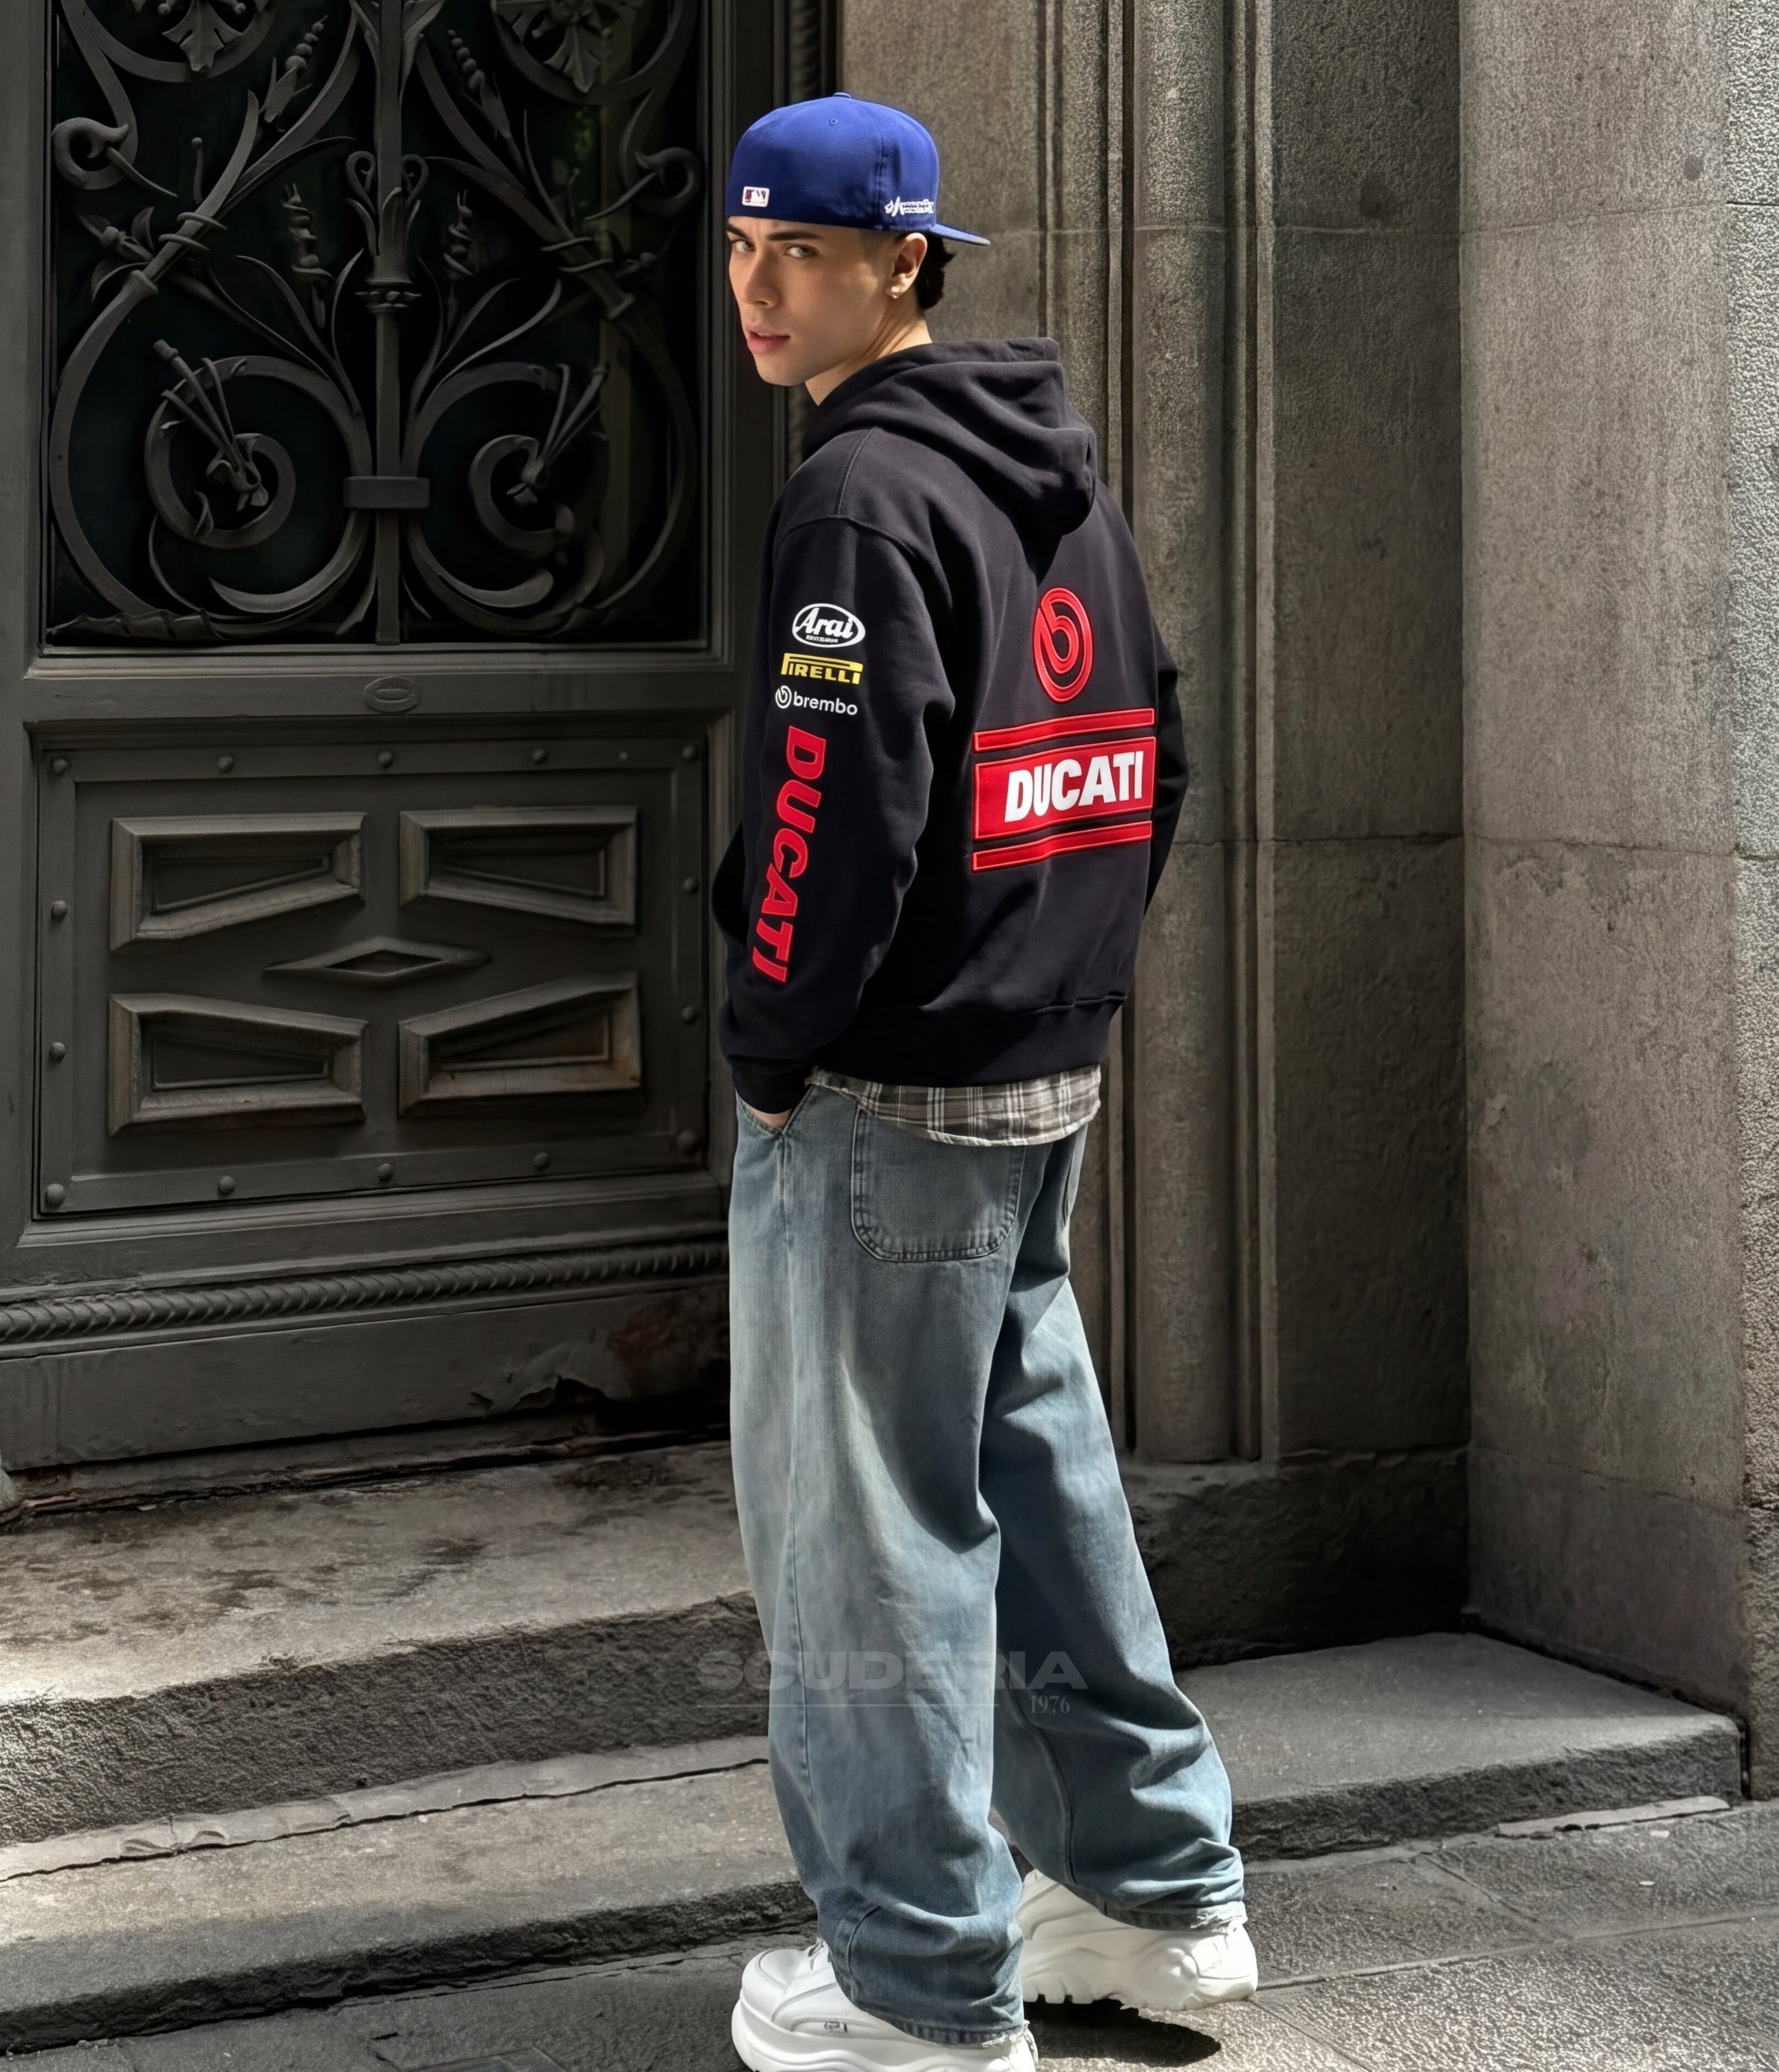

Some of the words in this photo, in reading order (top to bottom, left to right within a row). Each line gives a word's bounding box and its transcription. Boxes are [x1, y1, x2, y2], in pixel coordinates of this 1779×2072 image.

[794, 607, 853, 639] Arai
[781, 653, 863, 685] PIRELLI
[793, 691, 858, 716] brembo
[1004, 750, 1143, 823] DUCATI
[752, 725, 826, 983] DUCATI
